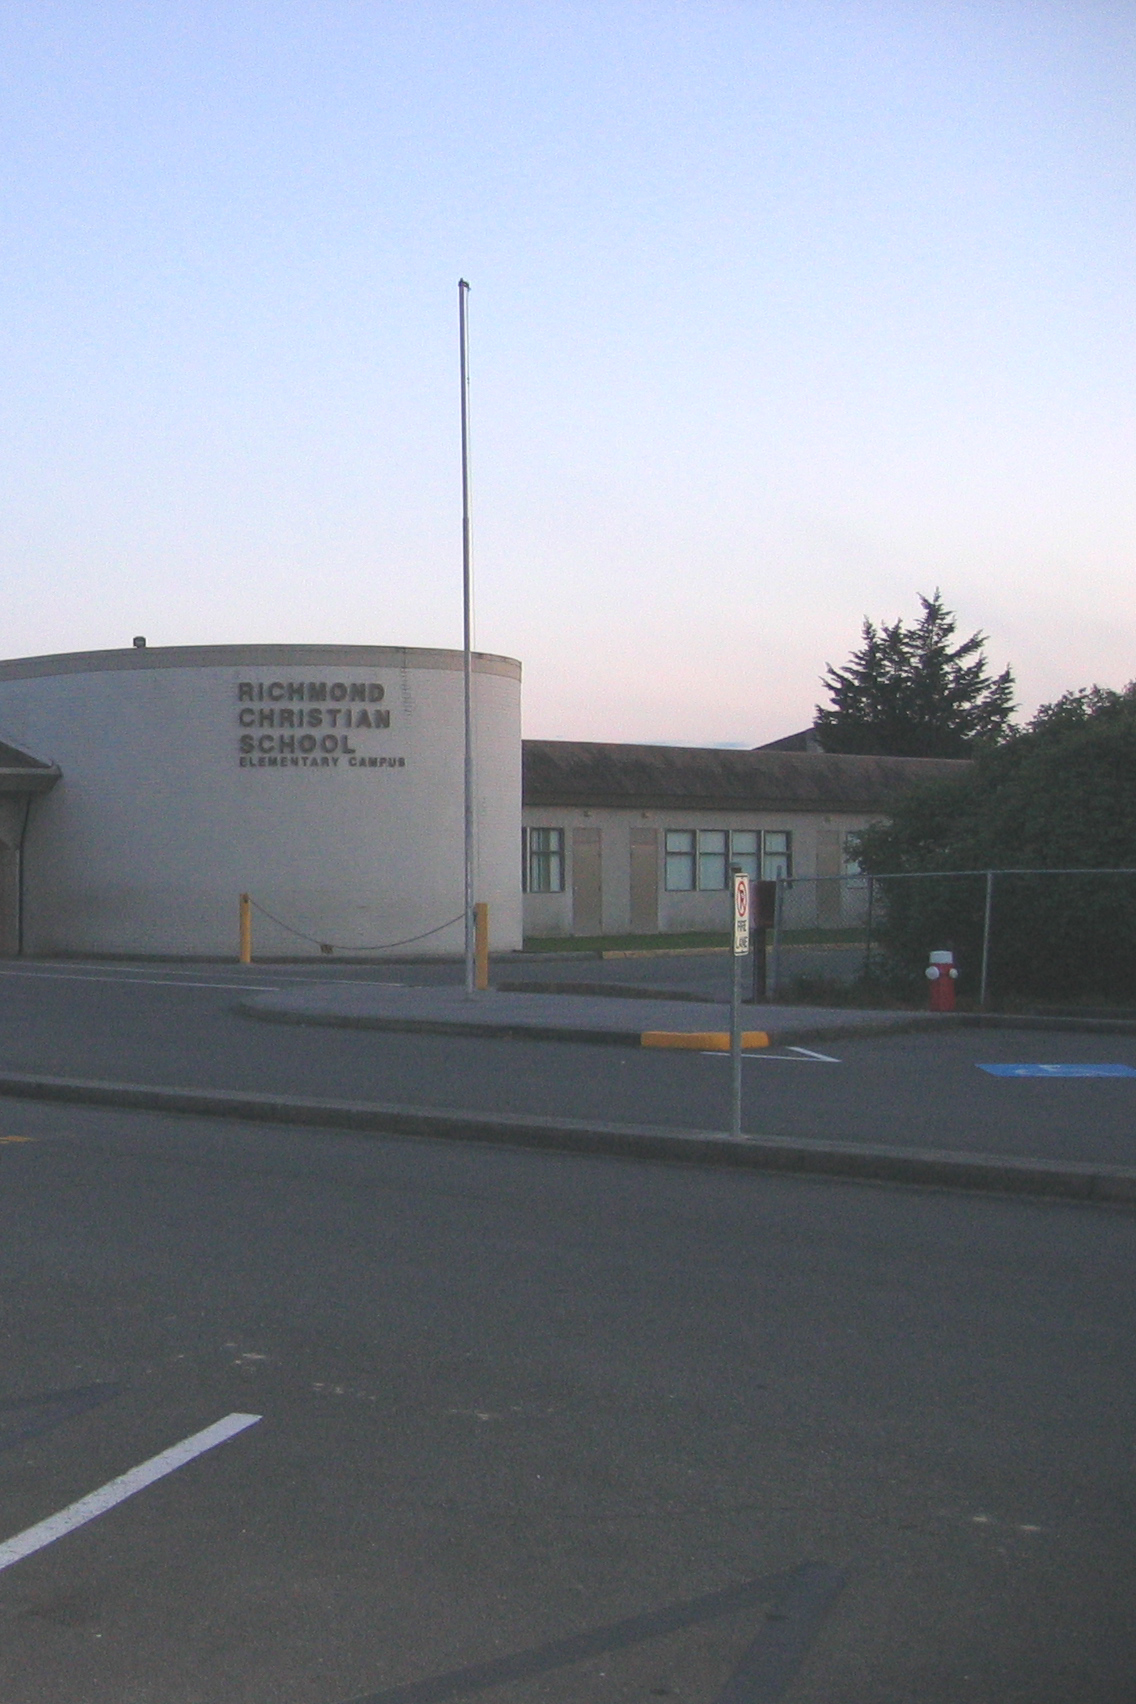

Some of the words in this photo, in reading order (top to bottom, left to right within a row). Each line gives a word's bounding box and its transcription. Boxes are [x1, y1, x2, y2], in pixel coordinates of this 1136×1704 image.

[238, 682, 385, 702] RICHMOND
[239, 708, 391, 729] CHRISTIAN
[239, 734, 356, 754] SCHOOL
[239, 756, 340, 768] ELEMENTARY
[348, 757, 406, 768] CAMPUS
